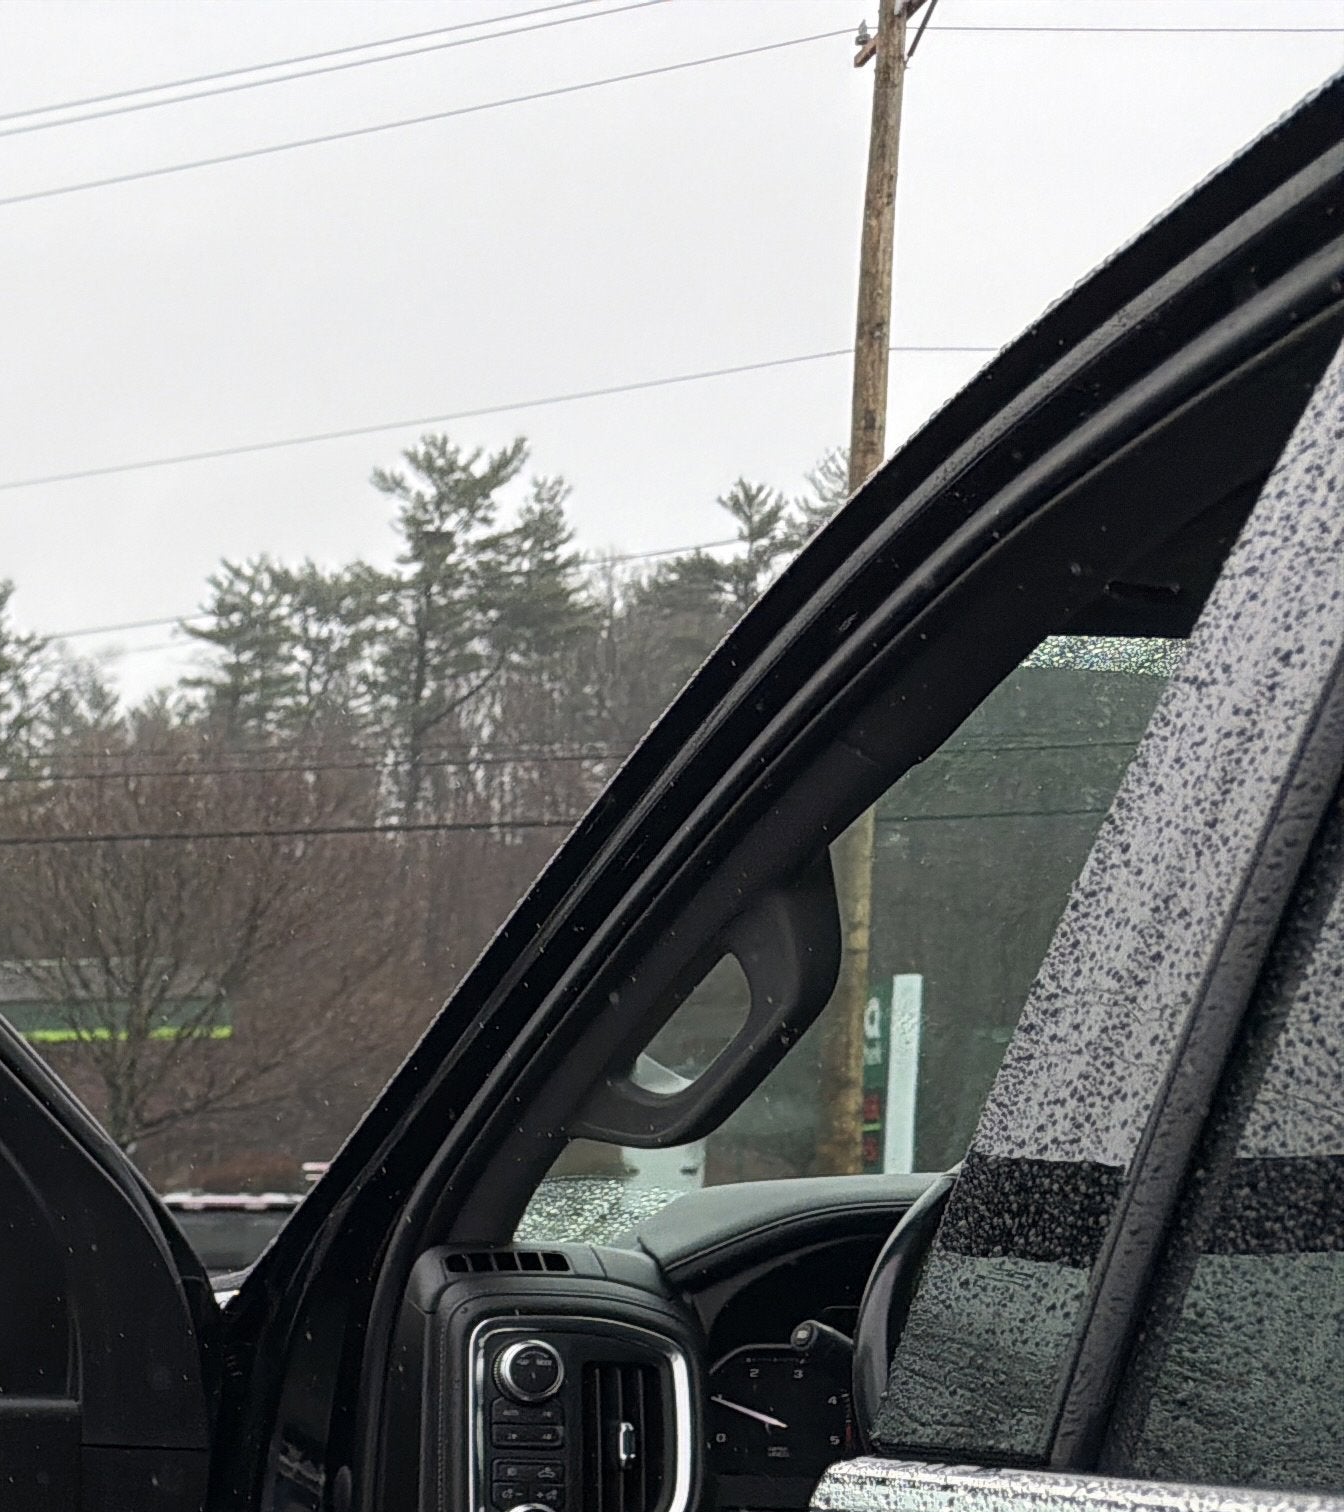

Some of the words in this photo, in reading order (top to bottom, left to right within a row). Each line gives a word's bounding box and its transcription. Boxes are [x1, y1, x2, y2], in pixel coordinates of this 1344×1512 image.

[749, 1368, 760, 1378] 2
[793, 1369, 804, 1379] 3
[827, 1395, 838, 1405] 4
[716, 1433, 727, 1443] 0
[829, 1435, 840, 1446] 5
